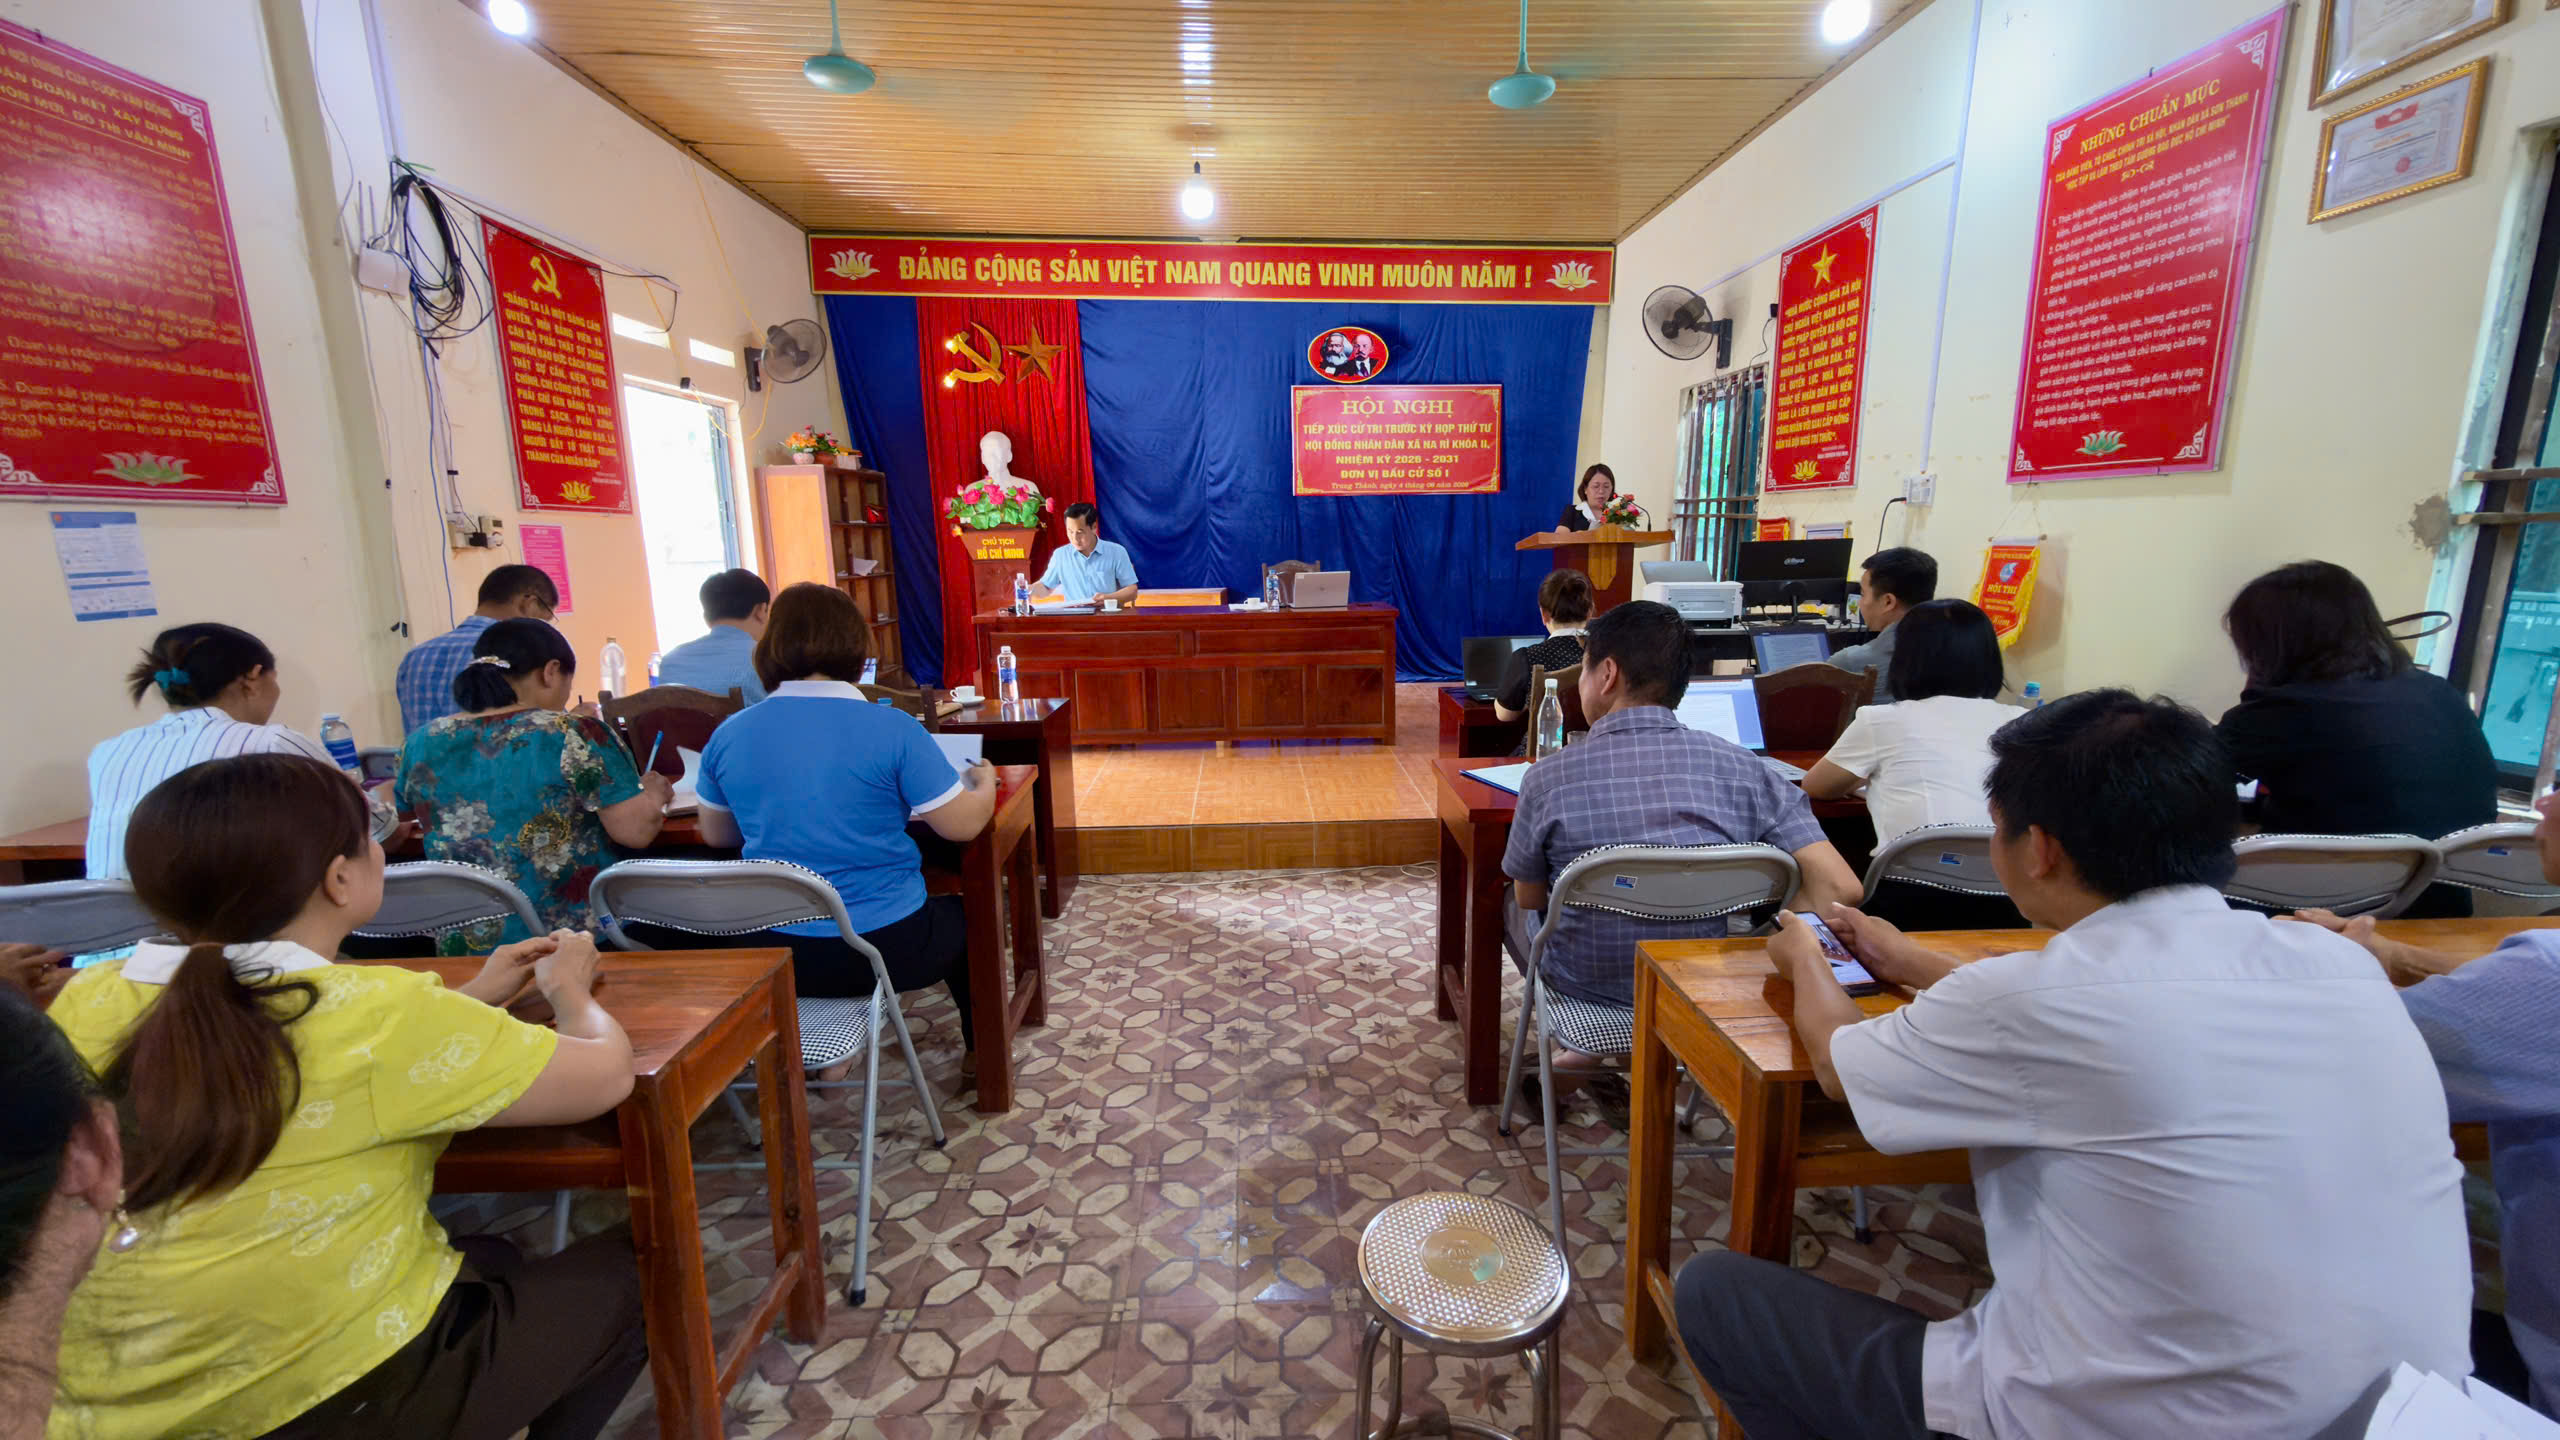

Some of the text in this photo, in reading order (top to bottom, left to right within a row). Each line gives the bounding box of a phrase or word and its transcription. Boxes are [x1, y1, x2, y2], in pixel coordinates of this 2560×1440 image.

[2080, 79, 2220, 155] NHỮNG CHUẨN MỰC
[899, 247, 1532, 288] ĐẢNG CỘNG SẢN VIỆT NAM QUANG VINH MUÔN NĂM !
[1341, 396, 1454, 418] HỘI NGHỊ
[1304, 421, 1493, 436] TIẾP XÚC CỬ TRI TRƯỚC KỲ HỌP THỨ TƯ
[1305, 440, 1322, 452] HỘI
[1324, 438, 1352, 450] ĐỒNG
[1354, 439, 1382, 450] NHÂN
[1384, 439, 1405, 449] DÂN
[1408, 438, 1421, 449] XÃ
[1423, 440, 1437, 449] NA
[1452, 438, 1478, 449] KHÓA
[1336, 454, 1374, 466] NHIỆM
[1377, 454, 1391, 464] KỲ
[1432, 455, 1460, 464] 2031
[1341, 469, 1365, 479] ĐƠN
[1368, 469, 1379, 480] VỊ
[1382, 467, 1405, 478] BẦU
[1408, 466, 1424, 478] CỬ
[1427, 466, 1443, 478] SỐ
[982, 537, 1015, 546] CHỦ TỊCH
[977, 546, 1024, 559] HỒ CHÍ MINH
